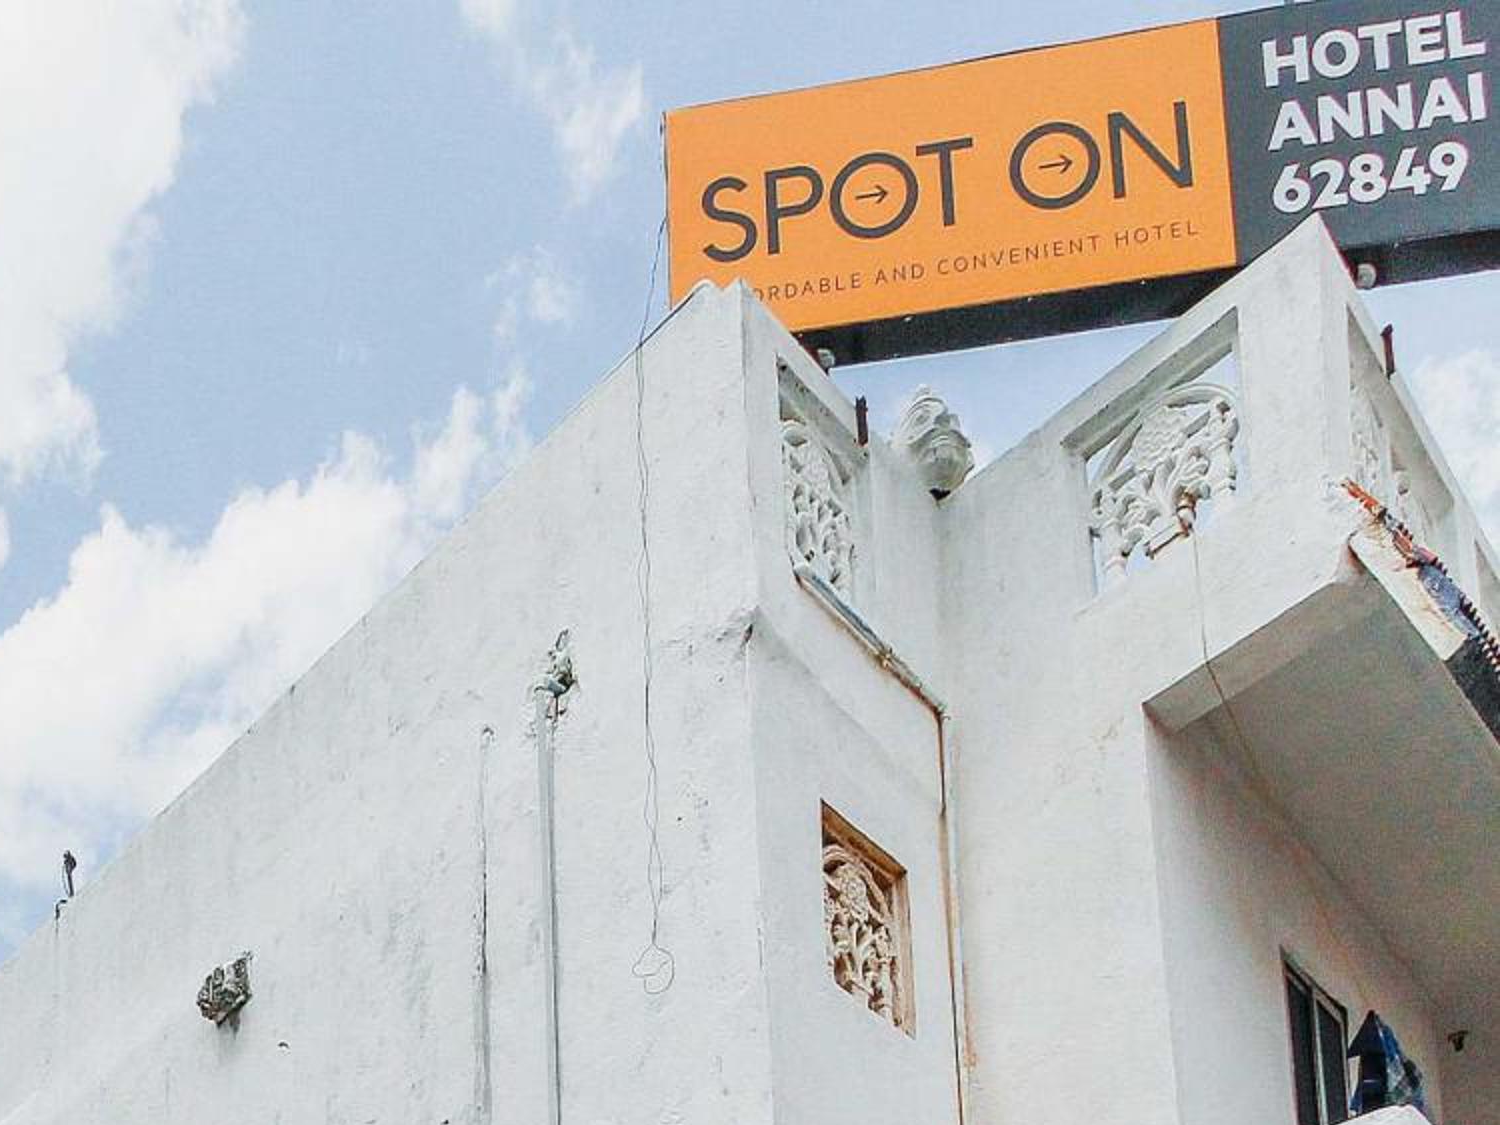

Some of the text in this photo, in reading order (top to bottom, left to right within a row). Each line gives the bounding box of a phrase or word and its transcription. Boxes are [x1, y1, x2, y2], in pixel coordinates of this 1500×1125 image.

[1261, 11, 1487, 87] HOTEL
[1268, 72, 1487, 151] ANNAI
[701, 101, 1194, 263] SPOT ON
[1273, 141, 1469, 213] 62849
[875, 263, 925, 285] AND
[937, 235, 1100, 275] CONVENIENT
[1114, 220, 1198, 249] HOTEL
